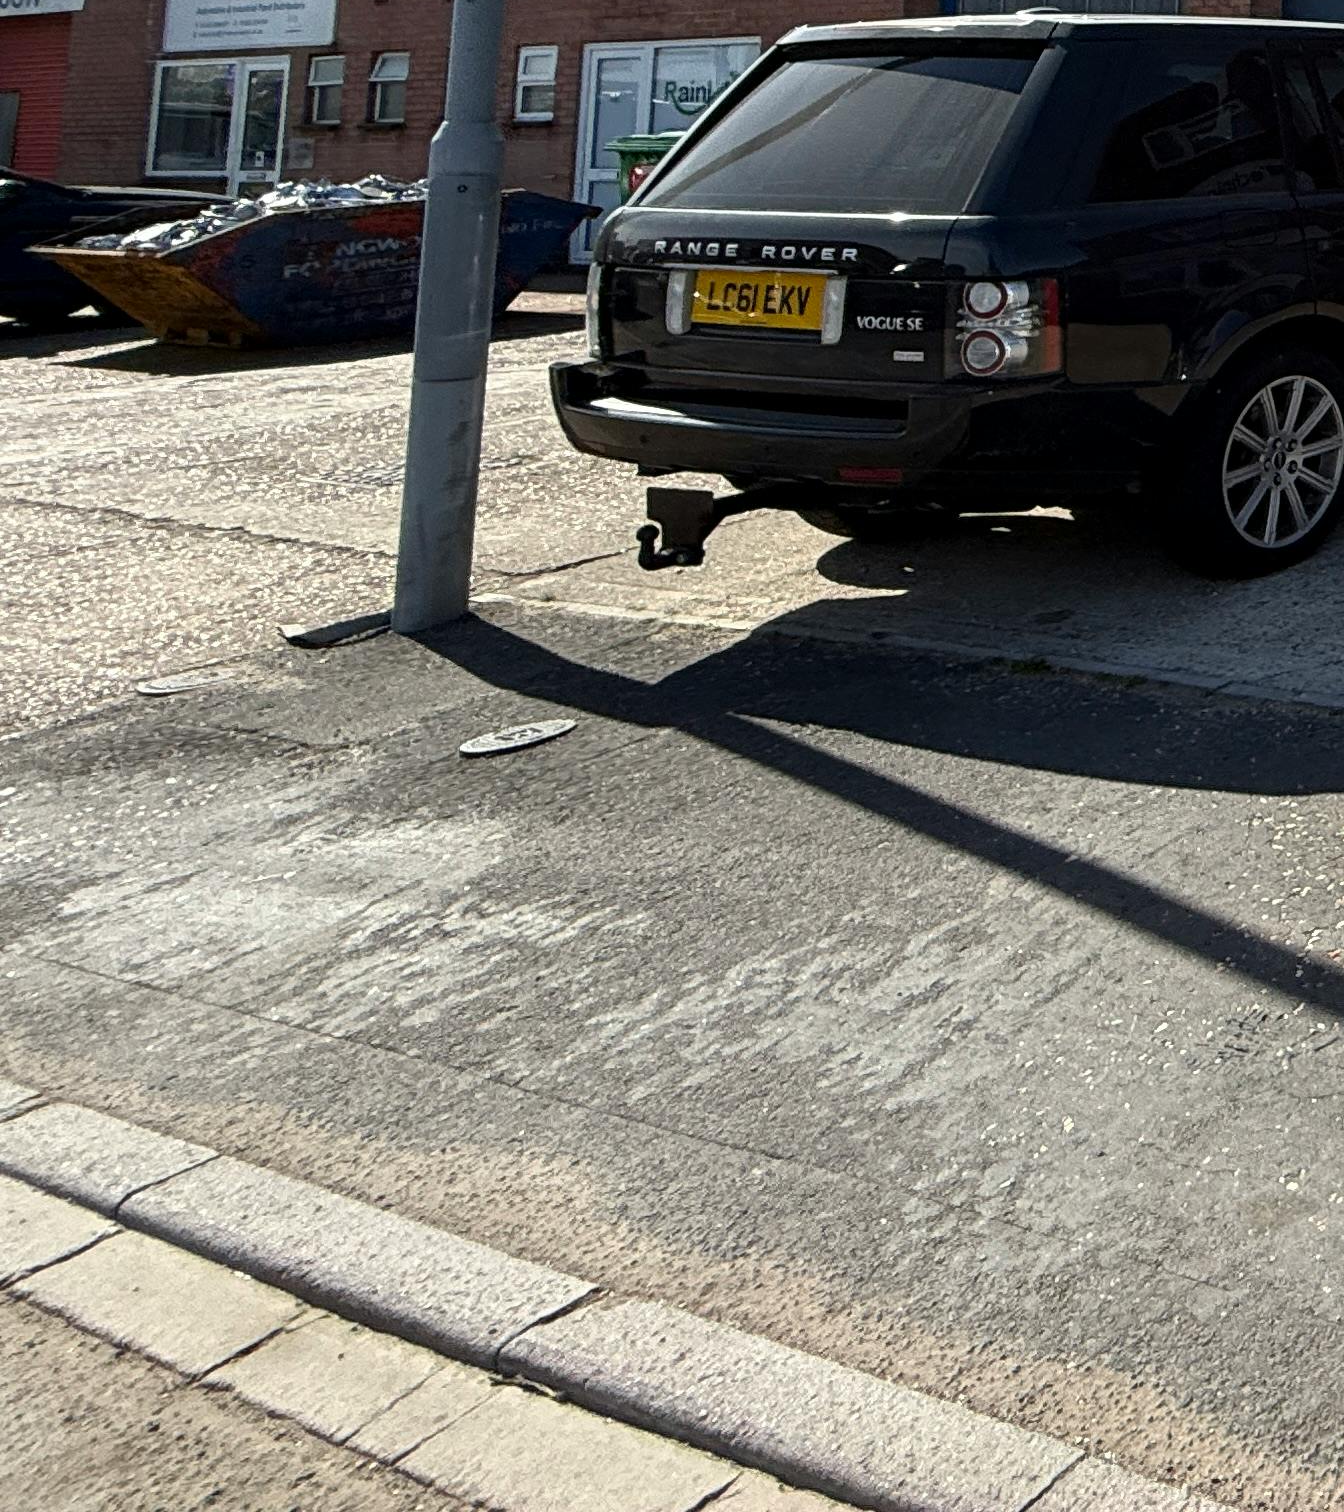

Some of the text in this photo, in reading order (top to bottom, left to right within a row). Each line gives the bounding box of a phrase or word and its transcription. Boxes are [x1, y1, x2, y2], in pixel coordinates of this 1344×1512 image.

[654, 240, 858, 262] RANGE ROVER
[706, 280, 810, 316] LC61 EKV
[856, 315, 924, 331] VOGUE SE
